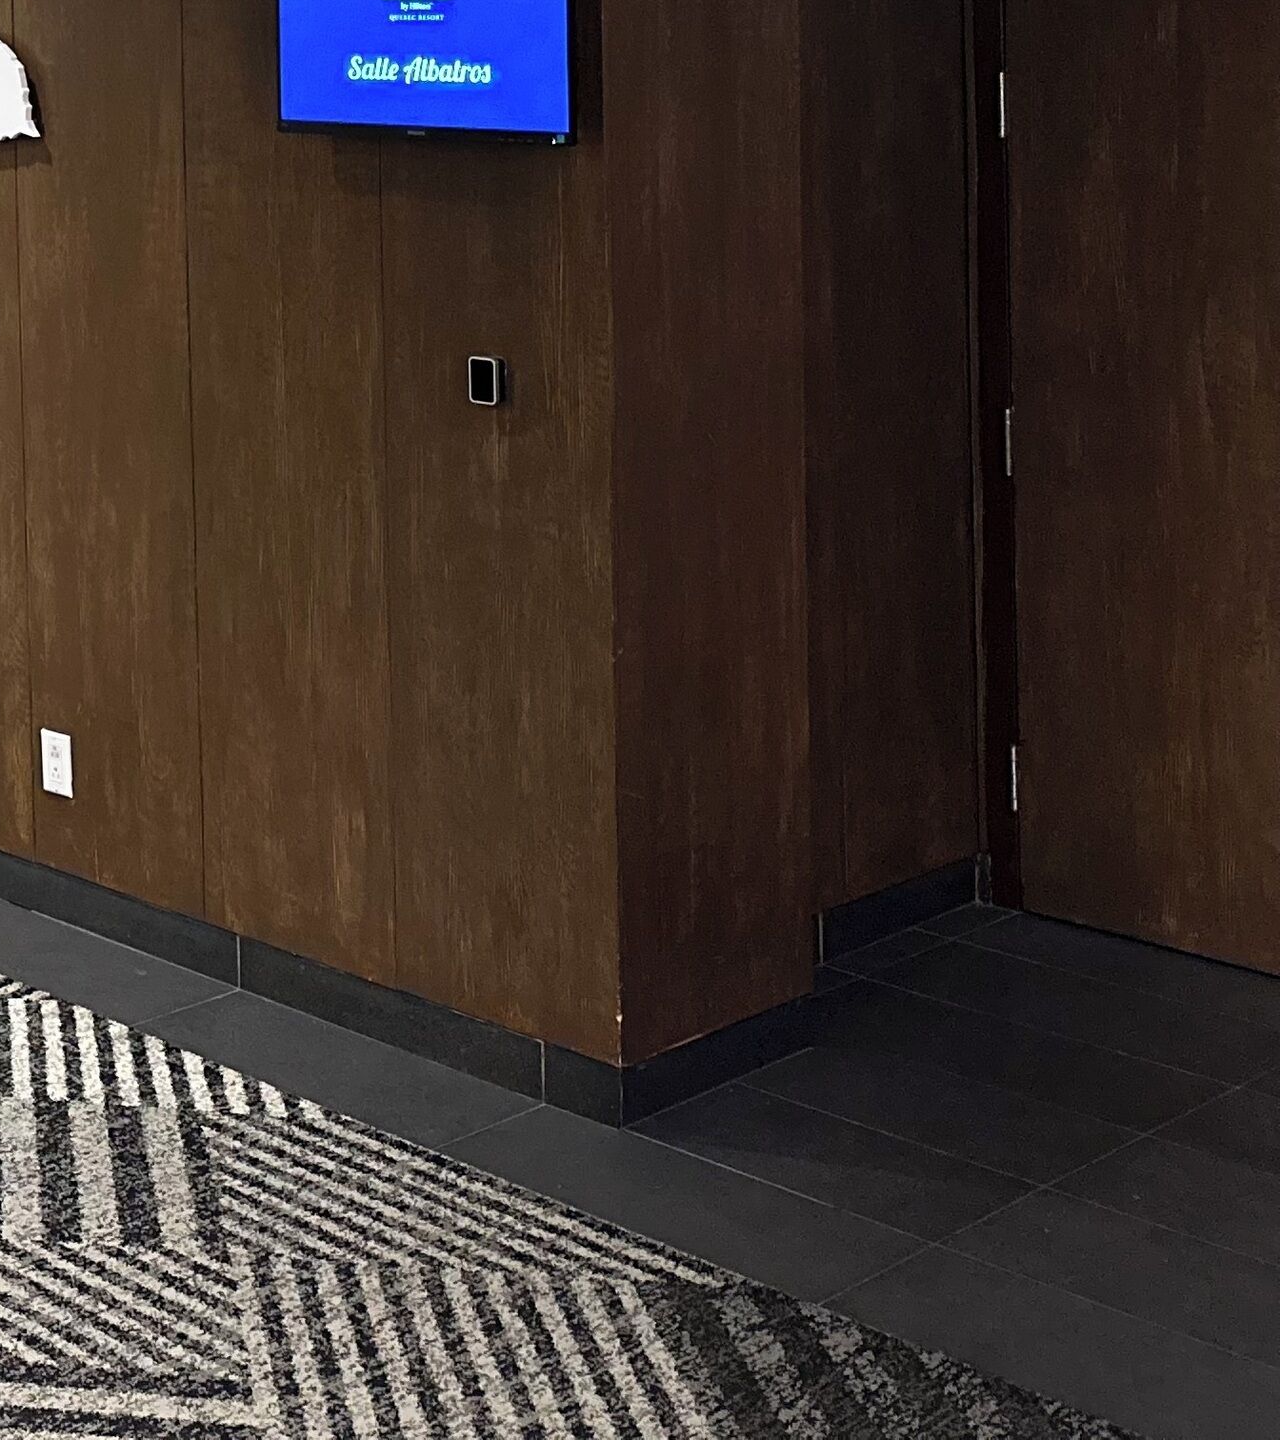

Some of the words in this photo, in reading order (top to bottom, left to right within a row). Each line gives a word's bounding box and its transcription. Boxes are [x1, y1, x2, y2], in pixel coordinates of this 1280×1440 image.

[400, 2, 409, 11] by
[348, 55, 399, 81] Salle
[403, 56, 491, 84] Albatros
